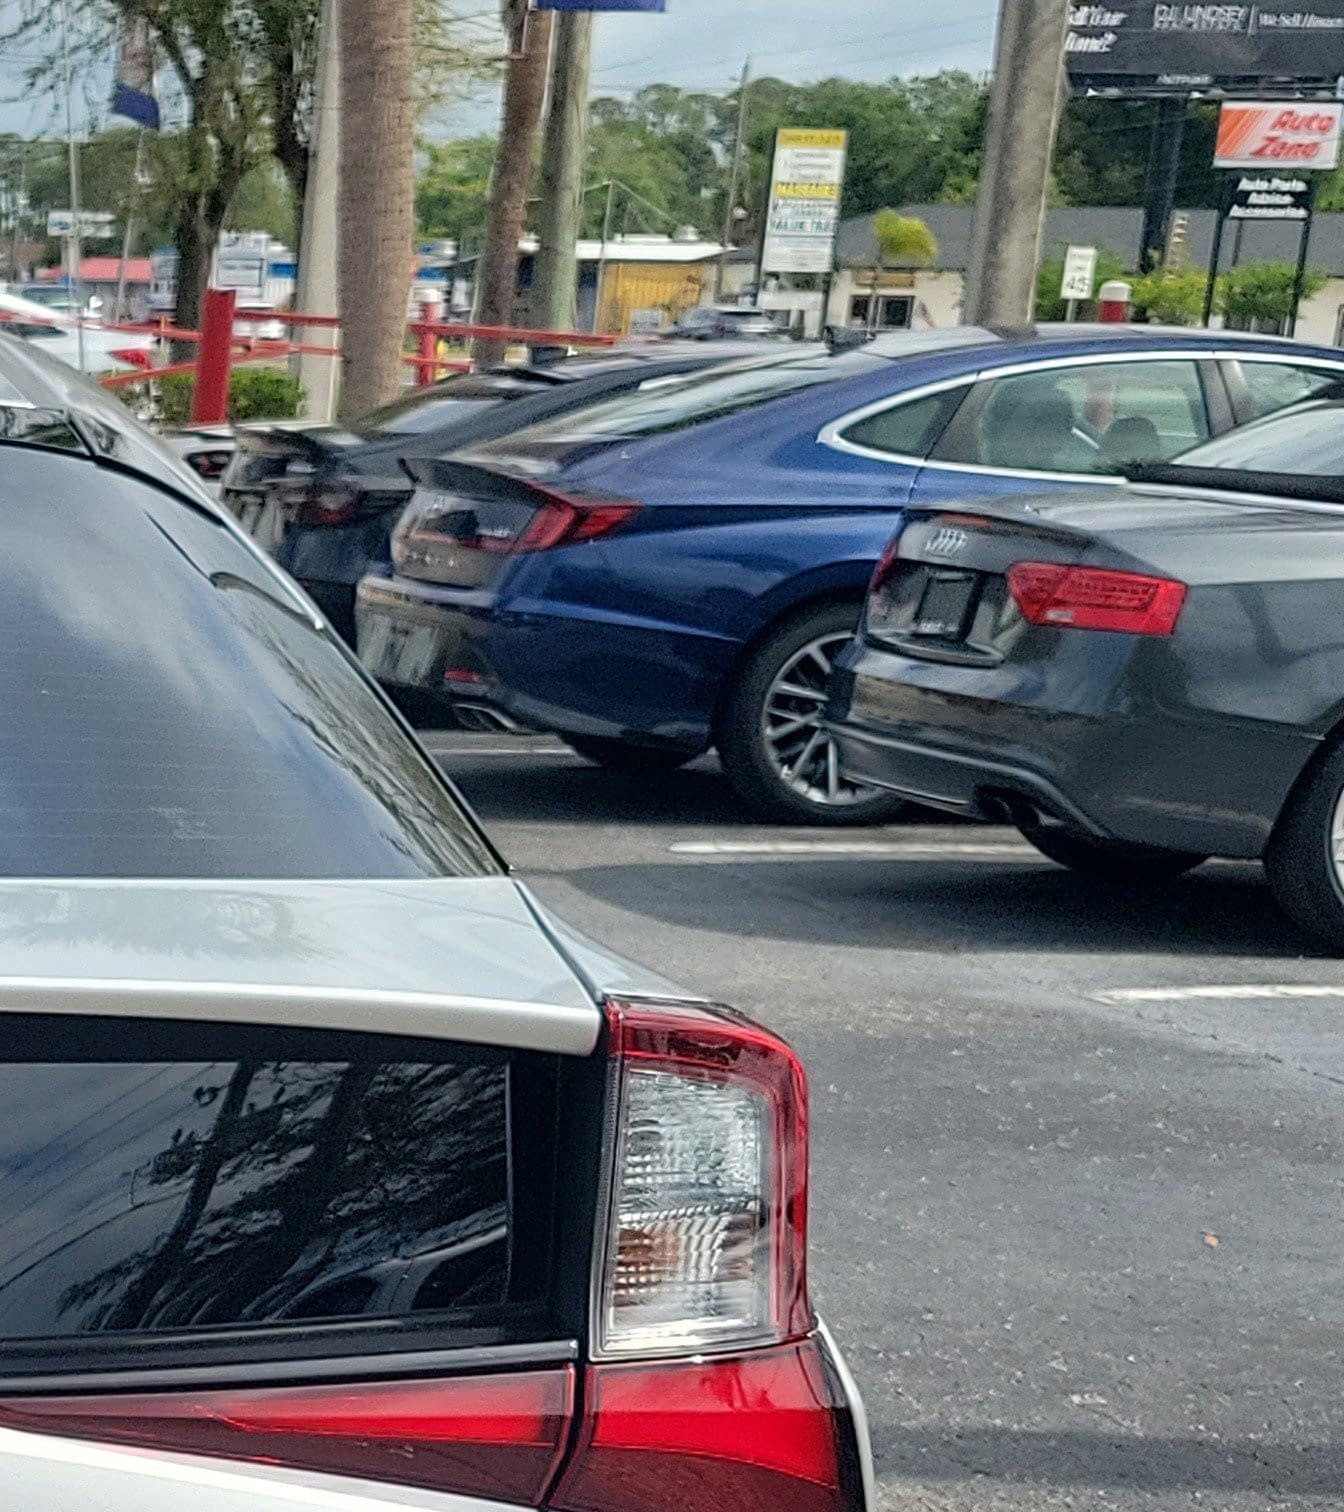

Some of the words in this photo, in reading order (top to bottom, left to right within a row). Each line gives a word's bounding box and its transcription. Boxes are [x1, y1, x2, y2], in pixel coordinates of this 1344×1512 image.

[1270, 110, 1336, 134] Auto
[1250, 135, 1322, 159] Zone
[1237, 177, 1270, 192] Auto
[1271, 177, 1308, 192] Parts
